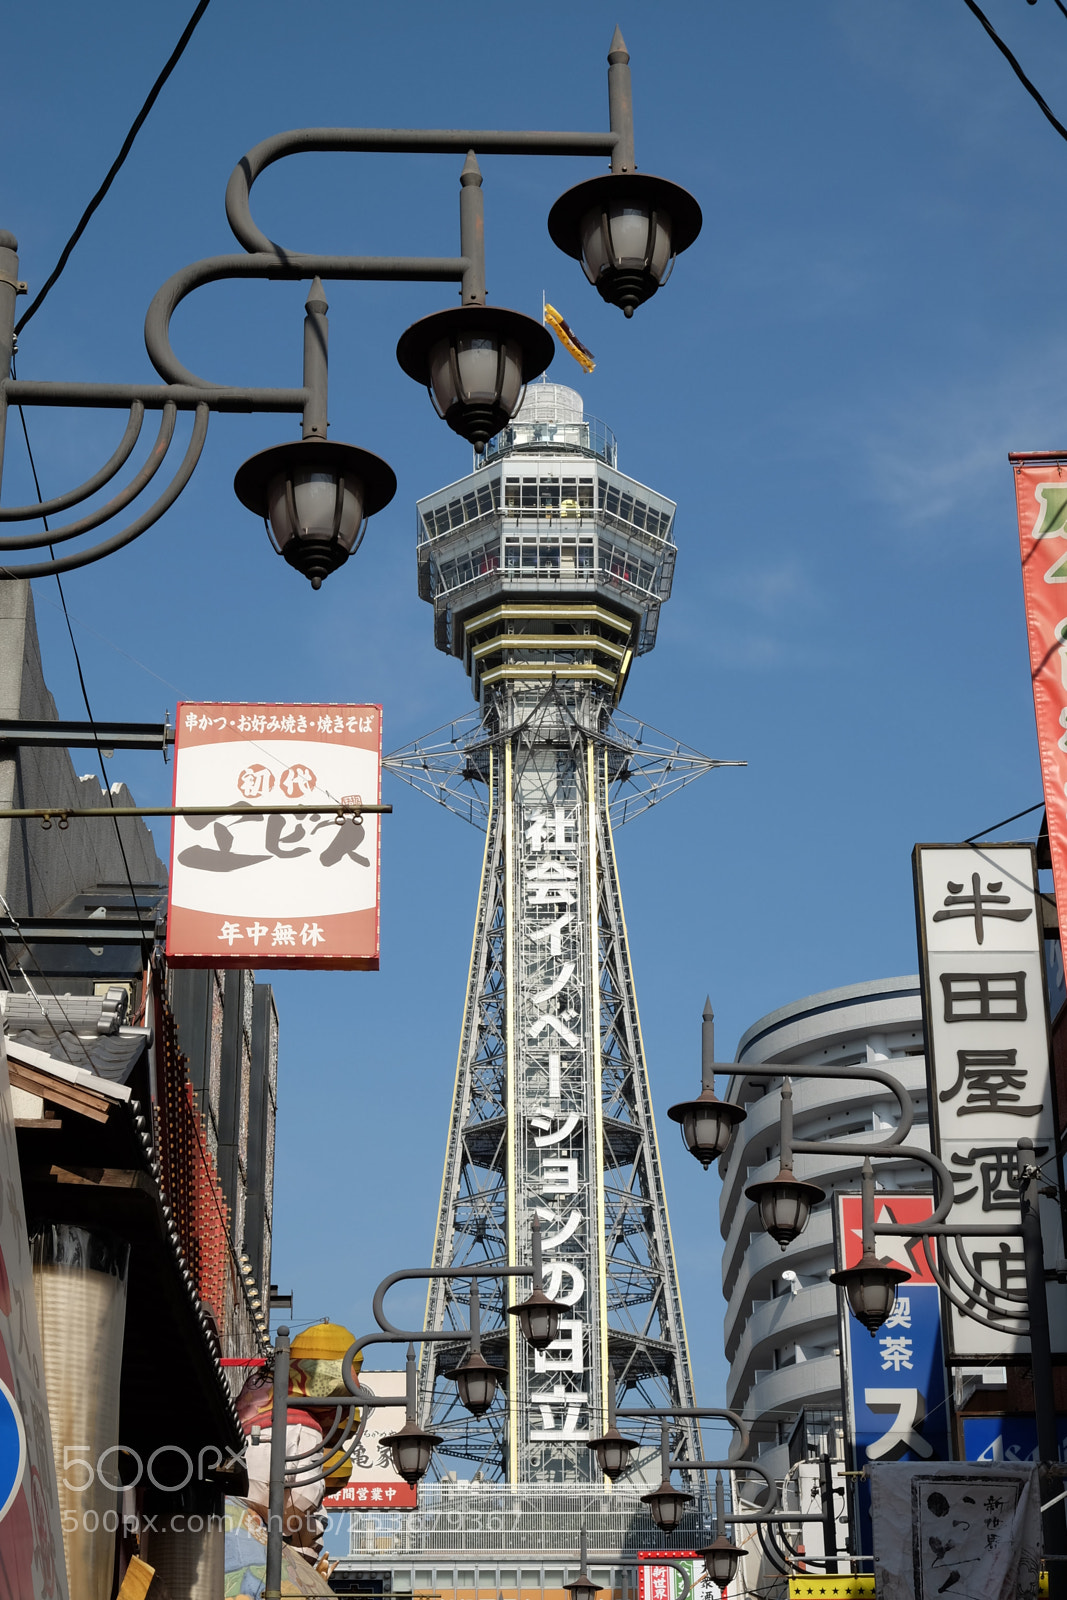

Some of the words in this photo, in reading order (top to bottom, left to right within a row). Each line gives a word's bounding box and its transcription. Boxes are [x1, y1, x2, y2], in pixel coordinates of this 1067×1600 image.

[184, 711, 374, 734] 串かつ・お好み焼き・焼きそば
[239, 766, 315, 797] 初代
[217, 920, 326, 947] 年中無休
[932, 871, 1049, 1321] 半田屋酒店
[322, 1486, 397, 1502] 時間営業中
